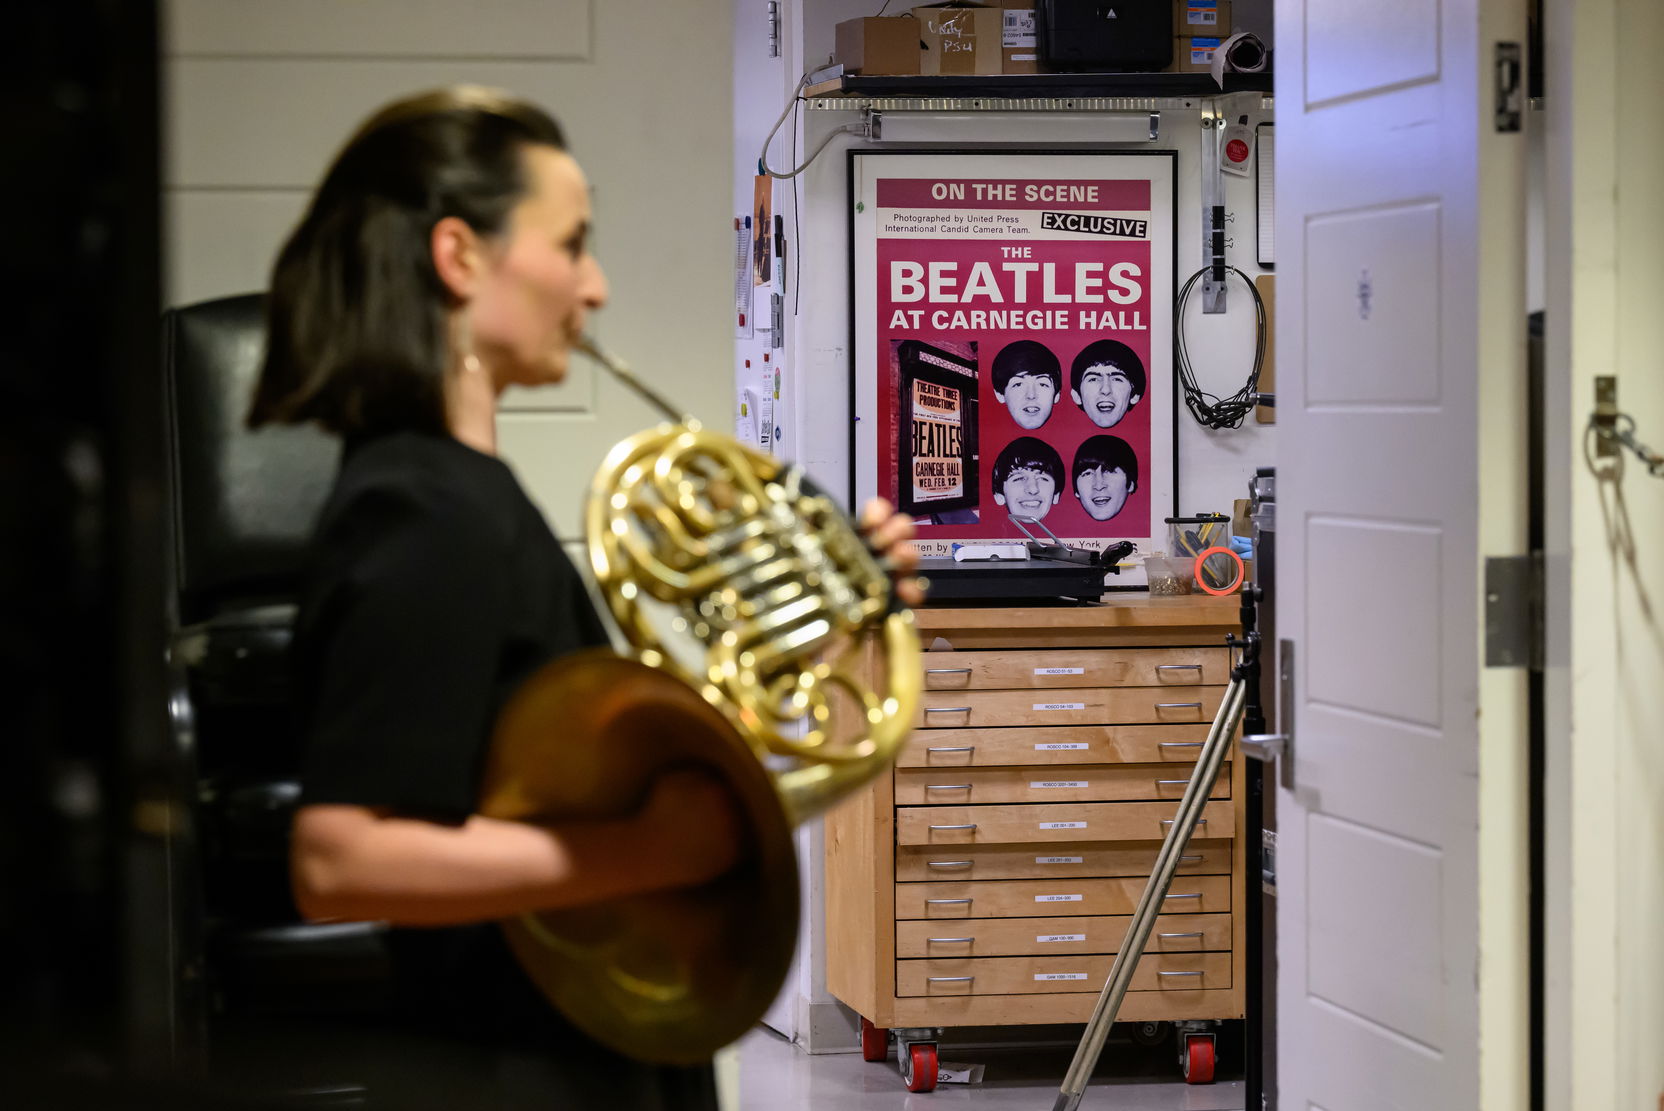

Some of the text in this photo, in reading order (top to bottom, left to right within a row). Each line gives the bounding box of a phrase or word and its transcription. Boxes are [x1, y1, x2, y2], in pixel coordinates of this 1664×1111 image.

[931, 182, 1100, 203] ON THE SCENE
[893, 213, 1020, 224] Photographed by United Press
[1041, 212, 1147, 238] EXCLUSIVE
[885, 224, 1031, 234] International Candid Camera Team.
[1000, 246, 1032, 259] THE
[890, 261, 1143, 305] BEATLES
[889, 310, 1147, 330] AT CARNEGIE HALL
[916, 381, 958, 401] THEATRE THREE
[919, 394, 956, 412] PRODUCTIONS
[913, 420, 962, 459] BEATLES
[916, 462, 960, 477] CARNEGIE HALL
[947, 477, 957, 487] 12
[937, 543, 949, 553] by
[1079, 540, 1101, 549] York
